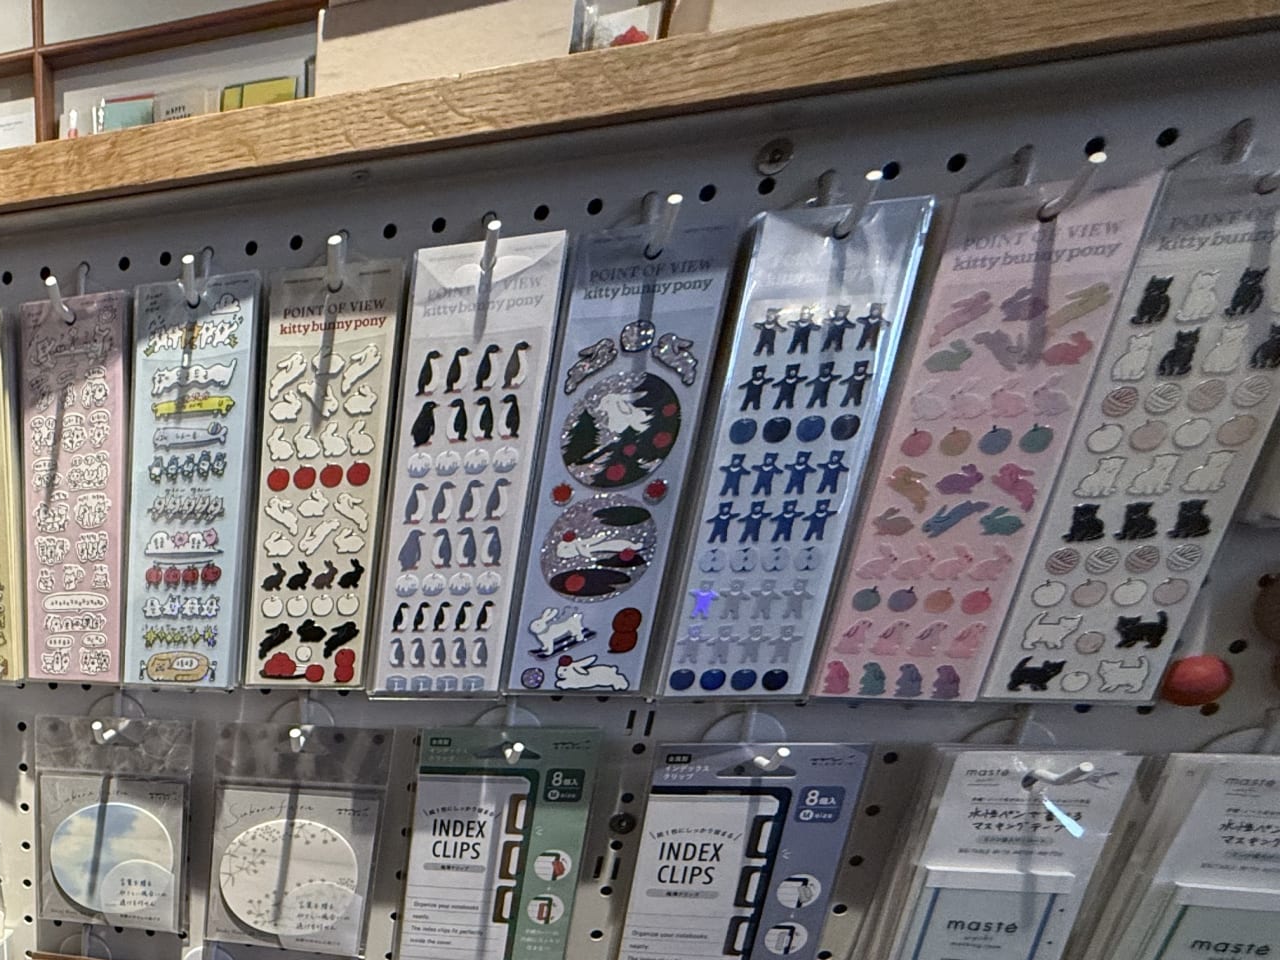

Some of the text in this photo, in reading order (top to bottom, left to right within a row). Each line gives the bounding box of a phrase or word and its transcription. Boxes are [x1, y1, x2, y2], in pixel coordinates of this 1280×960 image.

[588, 258, 712, 283] POINT OF VIEW
[282, 298, 387, 319] POINT OF VIEW
[432, 818, 487, 839] INDEX
[431, 840, 481, 860] CLIPS
[658, 841, 724, 862] INDEX
[656, 864, 716, 885] CLIPS
